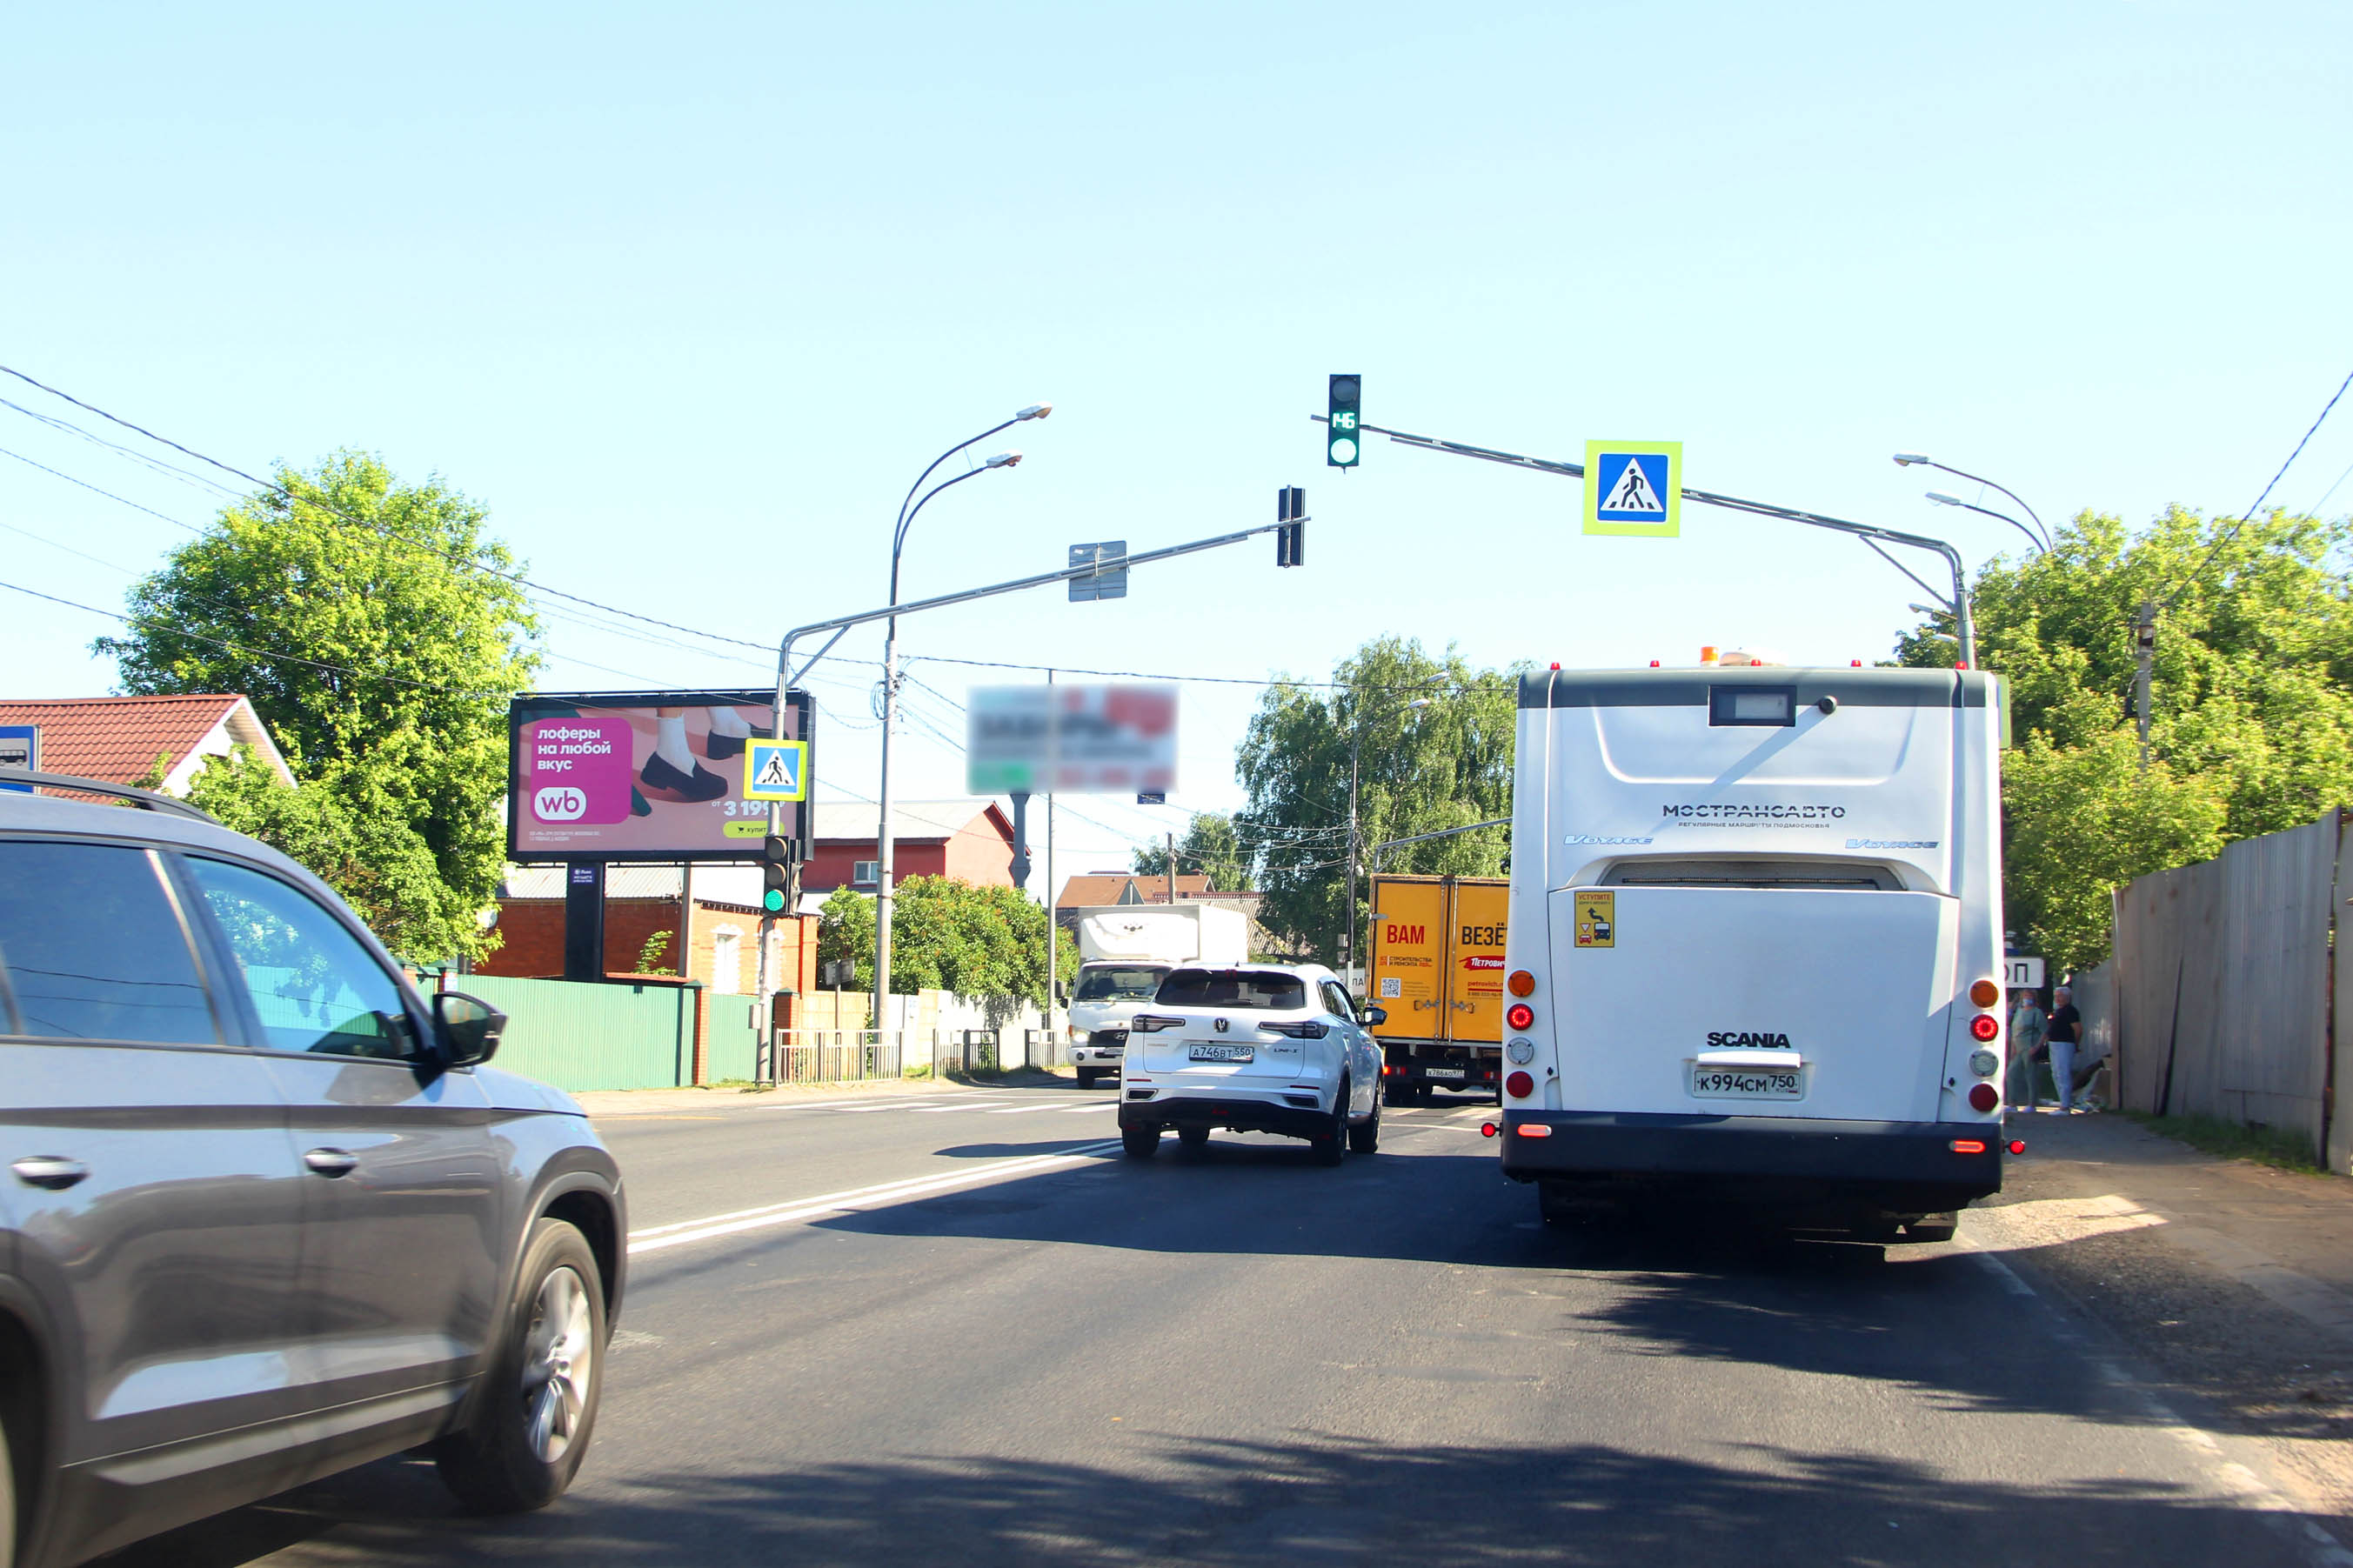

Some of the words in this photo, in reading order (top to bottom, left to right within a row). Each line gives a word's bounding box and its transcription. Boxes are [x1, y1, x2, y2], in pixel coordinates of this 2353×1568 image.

[538, 726, 601, 742] лоферы
[538, 744, 558, 755] на
[559, 741, 612, 754] любой
[538, 760, 573, 772] вкус
[541, 790, 580, 813] wb
[1663, 805, 1846, 818] МОСТРАНСАВТО
[1387, 924, 1425, 944] ВАМ
[1461, 923, 1507, 946] ВЕЗЁ
[1707, 1031, 1791, 1049] SCANIA
